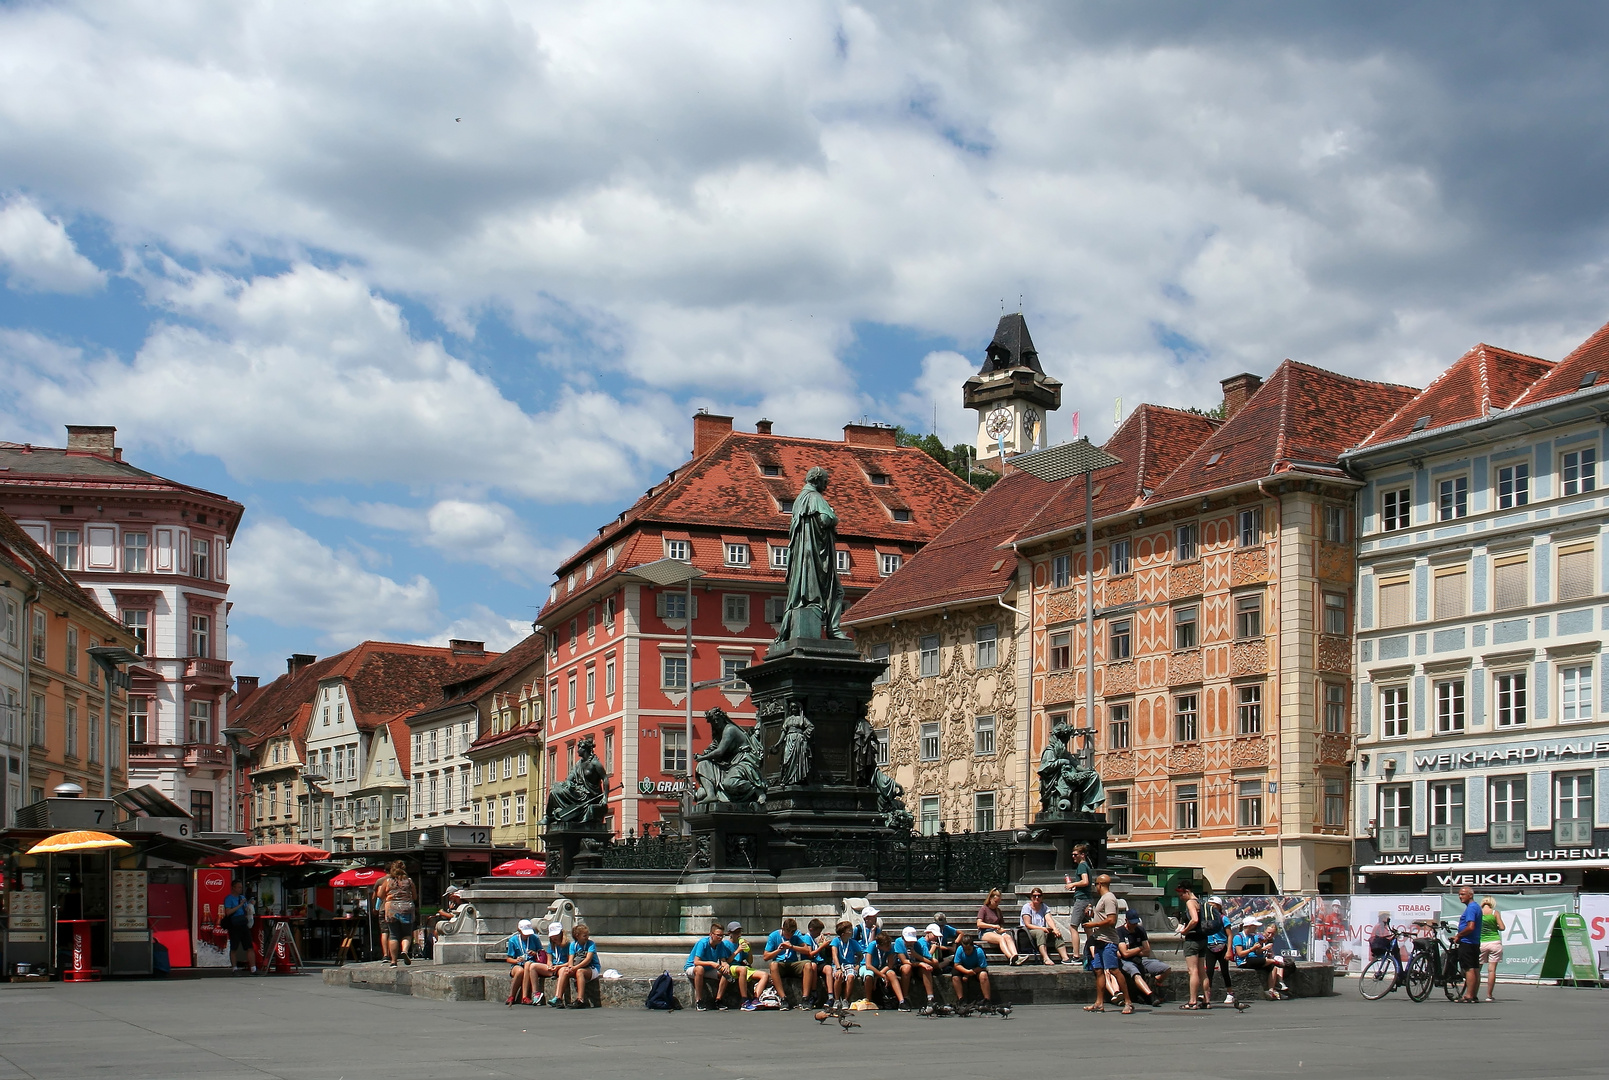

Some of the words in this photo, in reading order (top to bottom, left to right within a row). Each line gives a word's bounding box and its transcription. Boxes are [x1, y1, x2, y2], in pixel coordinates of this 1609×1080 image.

[1415, 746, 1538, 767] WEIKHARD
[1544, 741, 1609, 757] HAUS
[1269, 784, 1277, 792] W
[94, 809, 105, 825] 7
[179, 824, 188, 836] 6
[470, 832, 486, 844] 12
[1236, 847, 1263, 859] LUSH
[1374, 853, 1464, 865] JUWELIER
[1436, 873, 1562, 886] WEIKHARD
[1397, 904, 1431, 912] STRABAG
[73, 934, 83, 971] Coca-Cola
